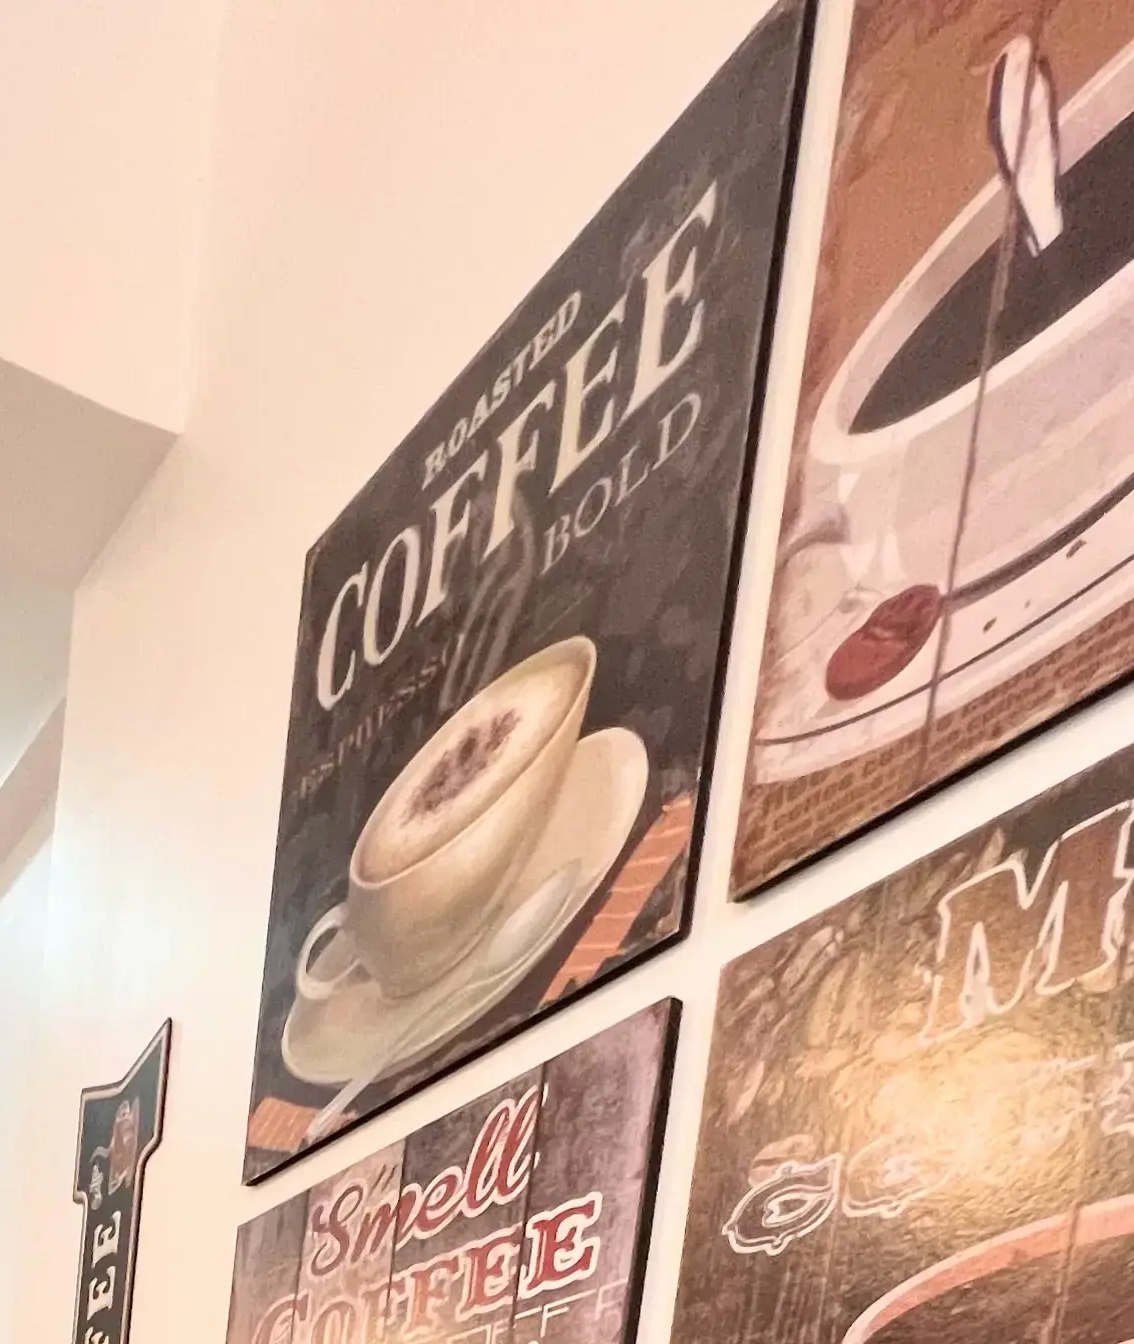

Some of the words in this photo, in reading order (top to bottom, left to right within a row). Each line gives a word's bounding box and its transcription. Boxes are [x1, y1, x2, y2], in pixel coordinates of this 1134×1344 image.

[316, 179, 718, 711] COFFEE
[422, 290, 582, 490] ROASTED
[540, 393, 702, 577] BOLD
[307, 1083, 544, 1281] Smell
